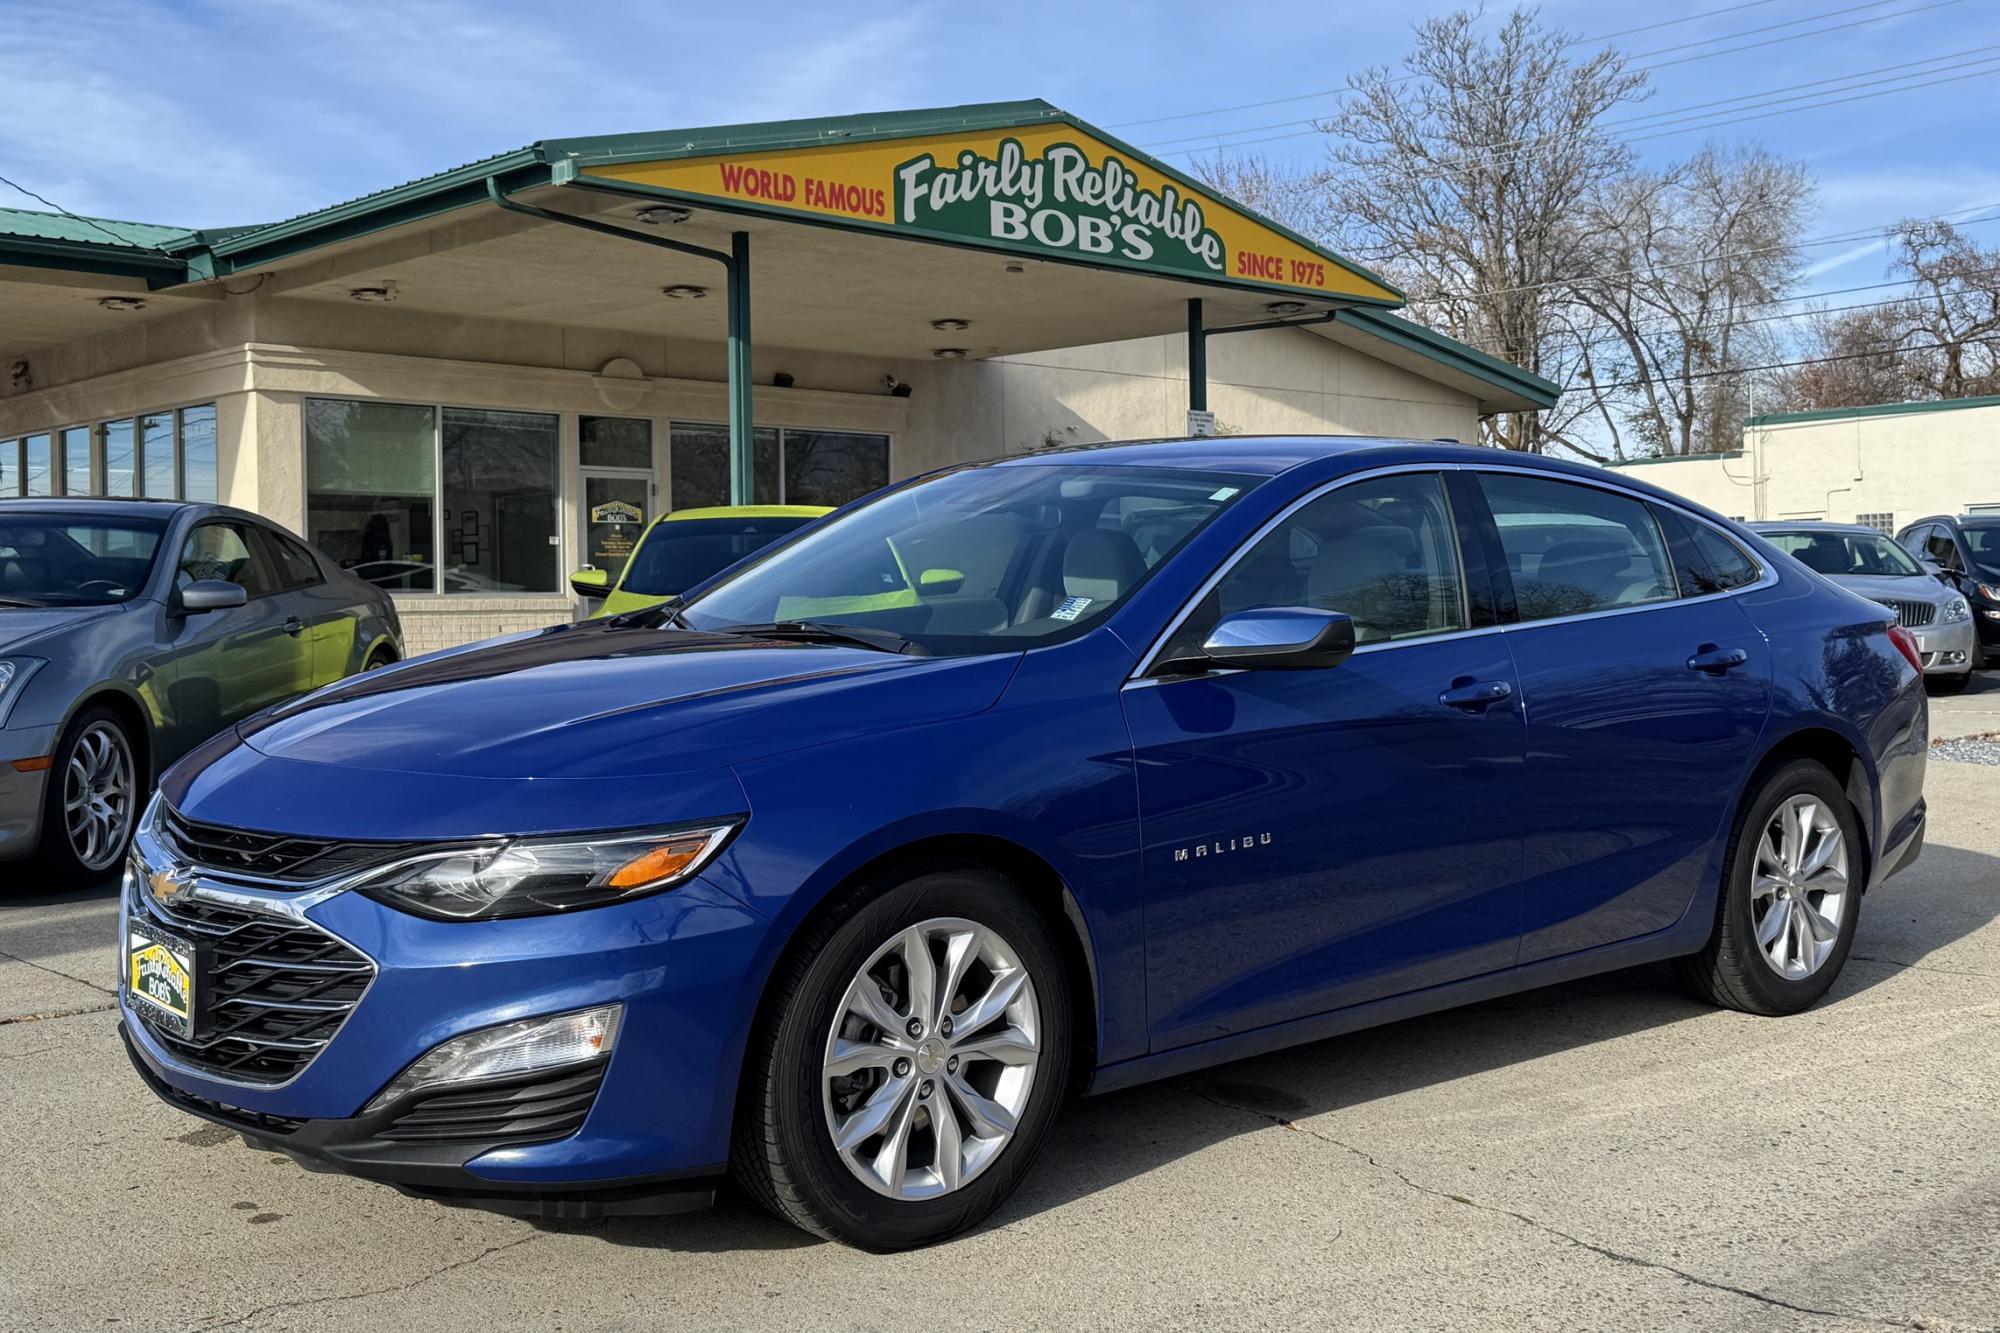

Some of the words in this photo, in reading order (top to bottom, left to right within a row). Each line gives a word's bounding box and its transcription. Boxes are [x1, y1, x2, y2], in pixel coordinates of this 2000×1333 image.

[719, 162, 797, 202] WORLD
[804, 178, 886, 217] FAMOUS
[900, 142, 1044, 223] Fairly
[1047, 146, 1223, 270] Reliable
[990, 200, 1154, 261] BOB'S
[1237, 250, 1284, 281] SINCE
[1289, 259, 1325, 287] 1975
[1174, 831, 1272, 861] MALIBU
[148, 976, 172, 1005] BOB'S
